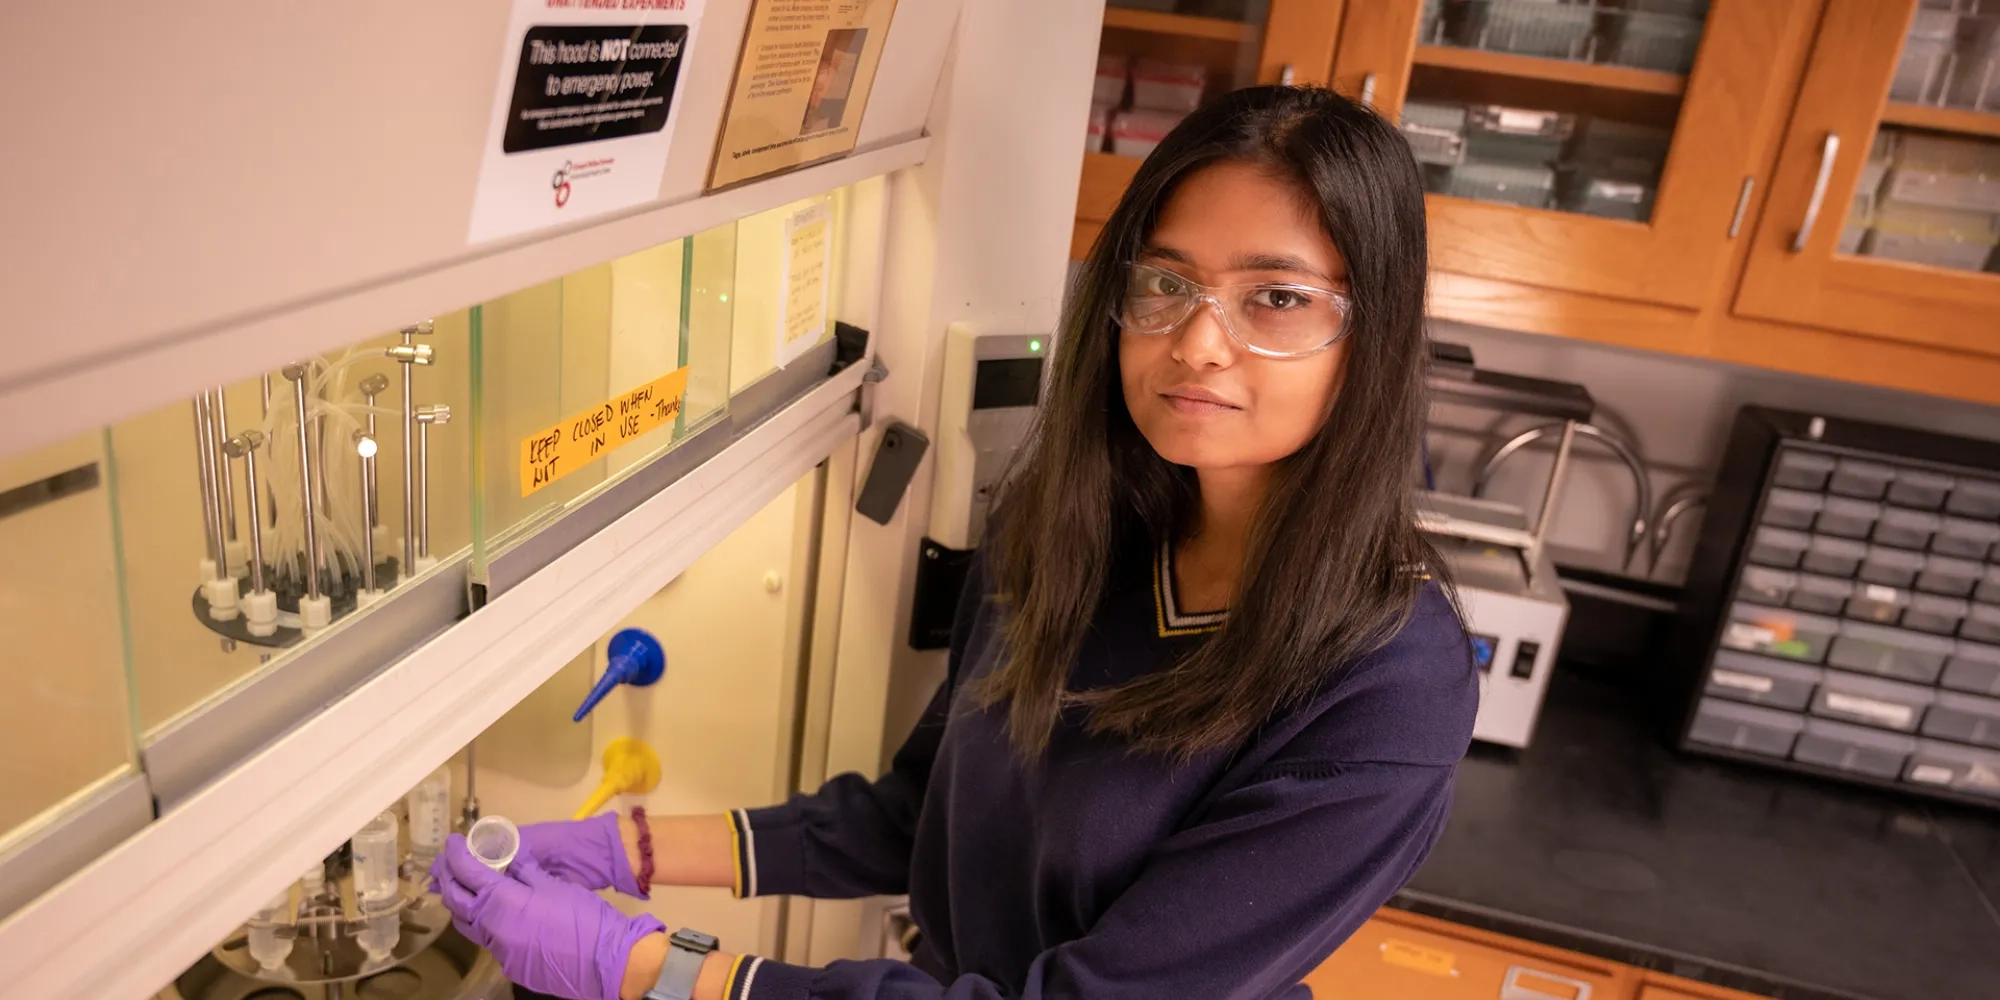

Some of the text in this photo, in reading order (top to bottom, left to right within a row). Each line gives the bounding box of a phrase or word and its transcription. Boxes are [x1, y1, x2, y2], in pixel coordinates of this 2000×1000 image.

[531, 38, 680, 65] This hood is NOT connected
[546, 75, 561, 96] to
[561, 73, 620, 98] emergency
[530, 386, 653, 464] KEEP CLOSED WHEN
[533, 456, 560, 488] NOT
[590, 432, 606, 456] IN
[620, 415, 640, 439] USE
